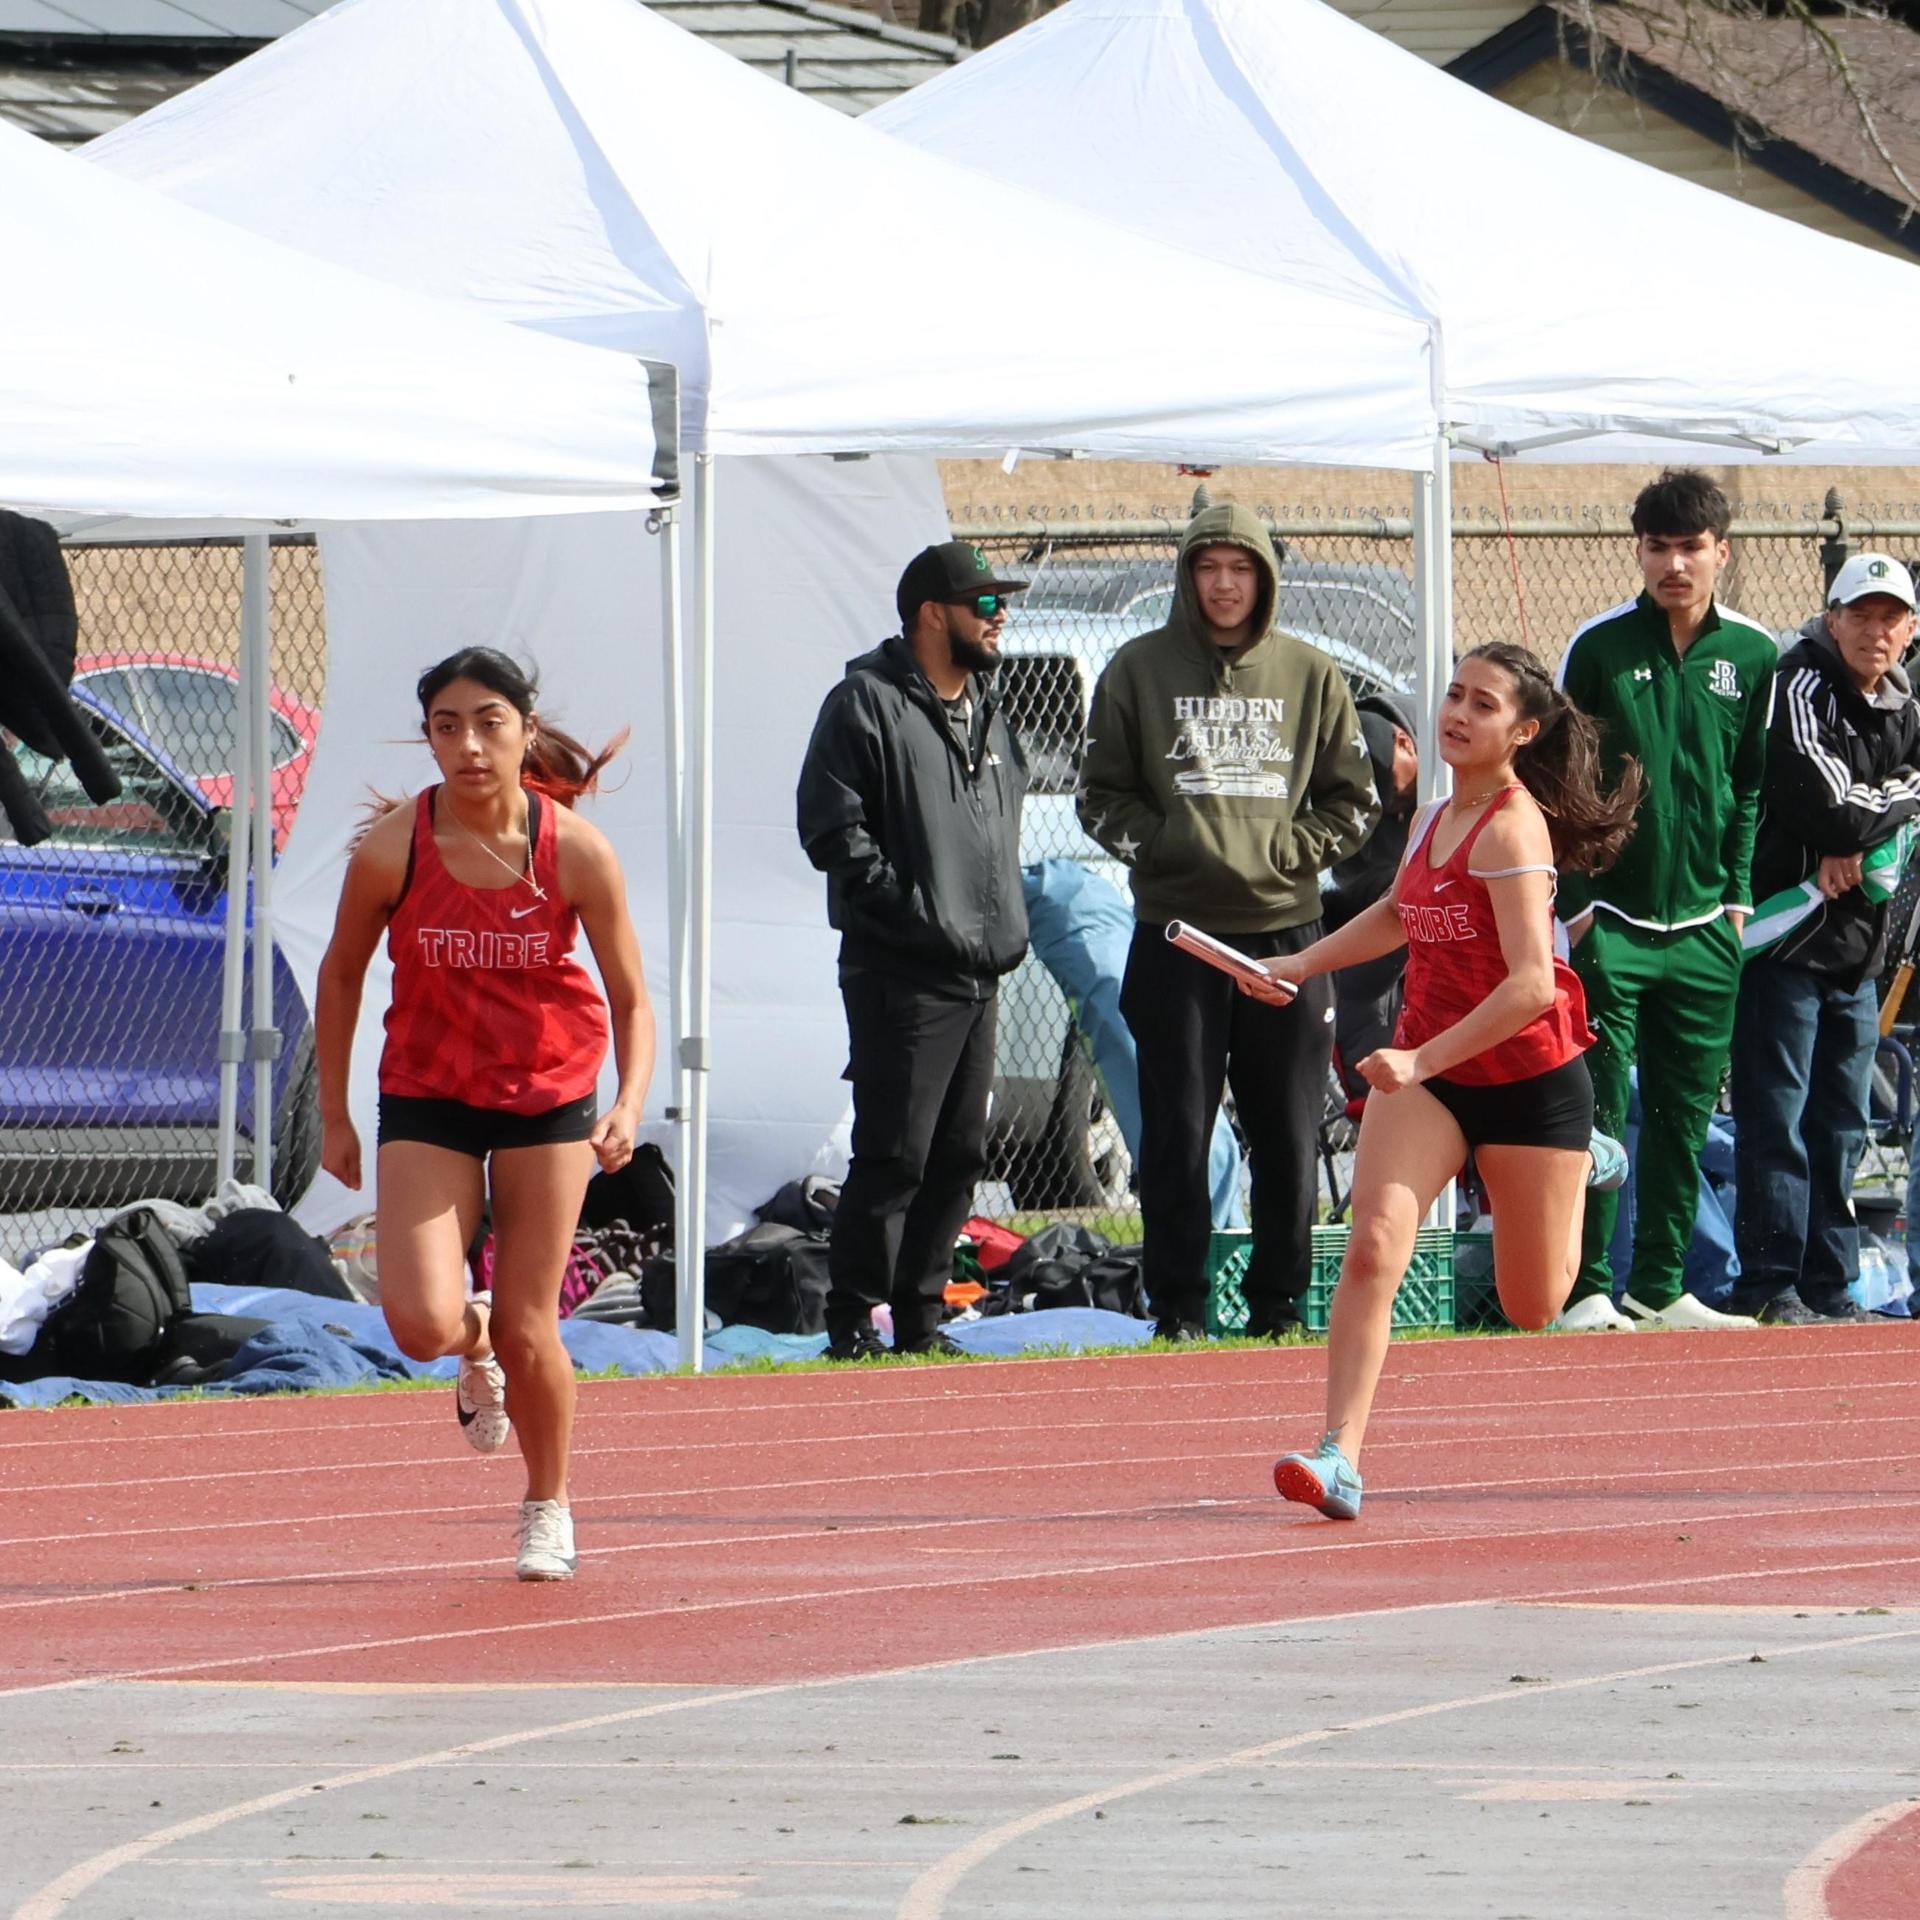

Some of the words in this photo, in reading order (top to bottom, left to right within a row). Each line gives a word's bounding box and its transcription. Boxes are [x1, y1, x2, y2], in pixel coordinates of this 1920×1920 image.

[1173, 696, 1285, 722] HIDDEN
[1190, 726, 1271, 751] HILLS
[418, 928, 550, 969] TRIBE
